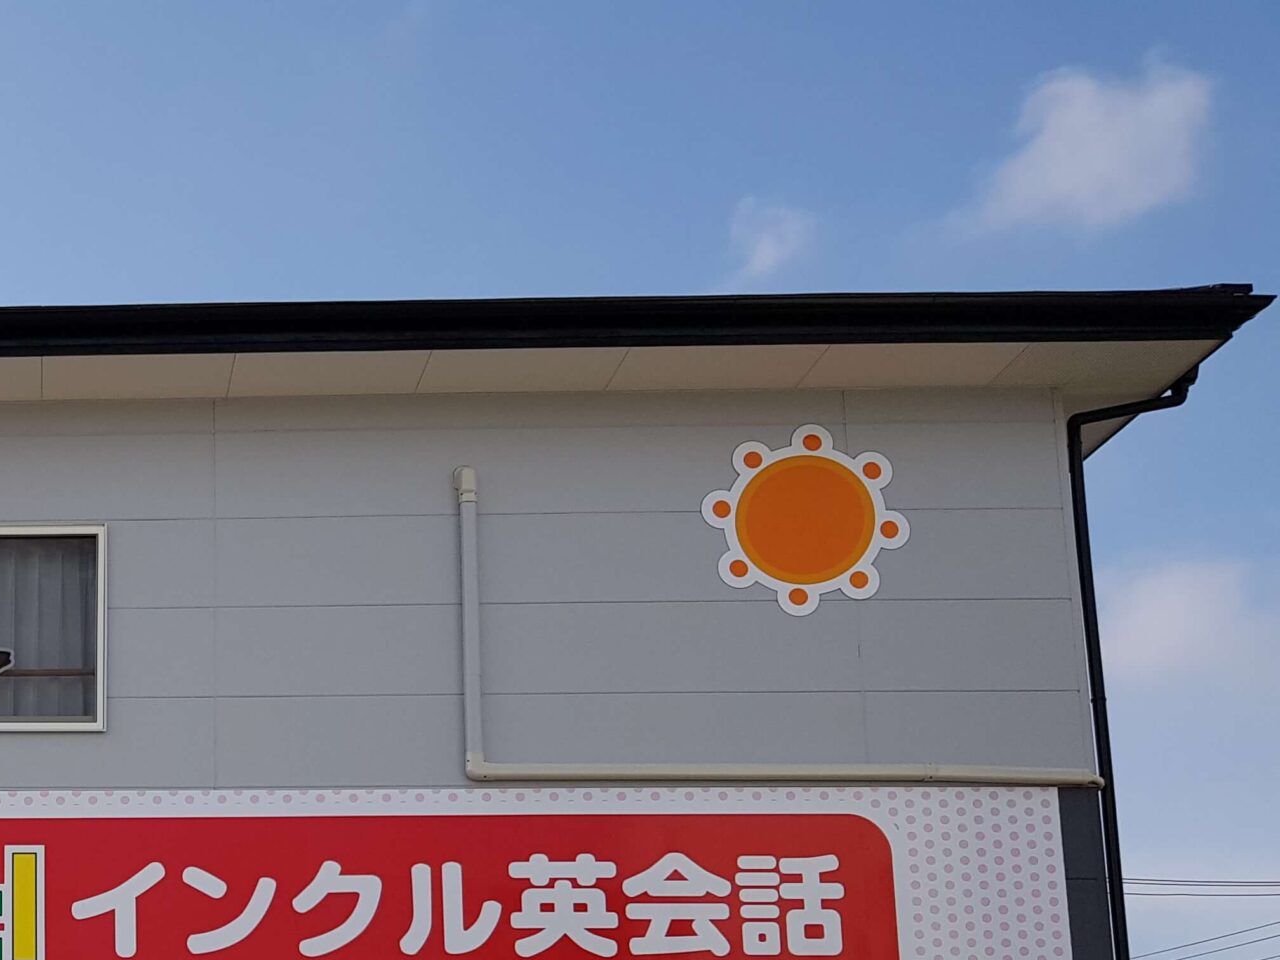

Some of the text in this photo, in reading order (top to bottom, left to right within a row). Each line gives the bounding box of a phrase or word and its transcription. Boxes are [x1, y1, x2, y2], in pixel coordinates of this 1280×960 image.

[71, 852, 846, 958] インクル英会話
